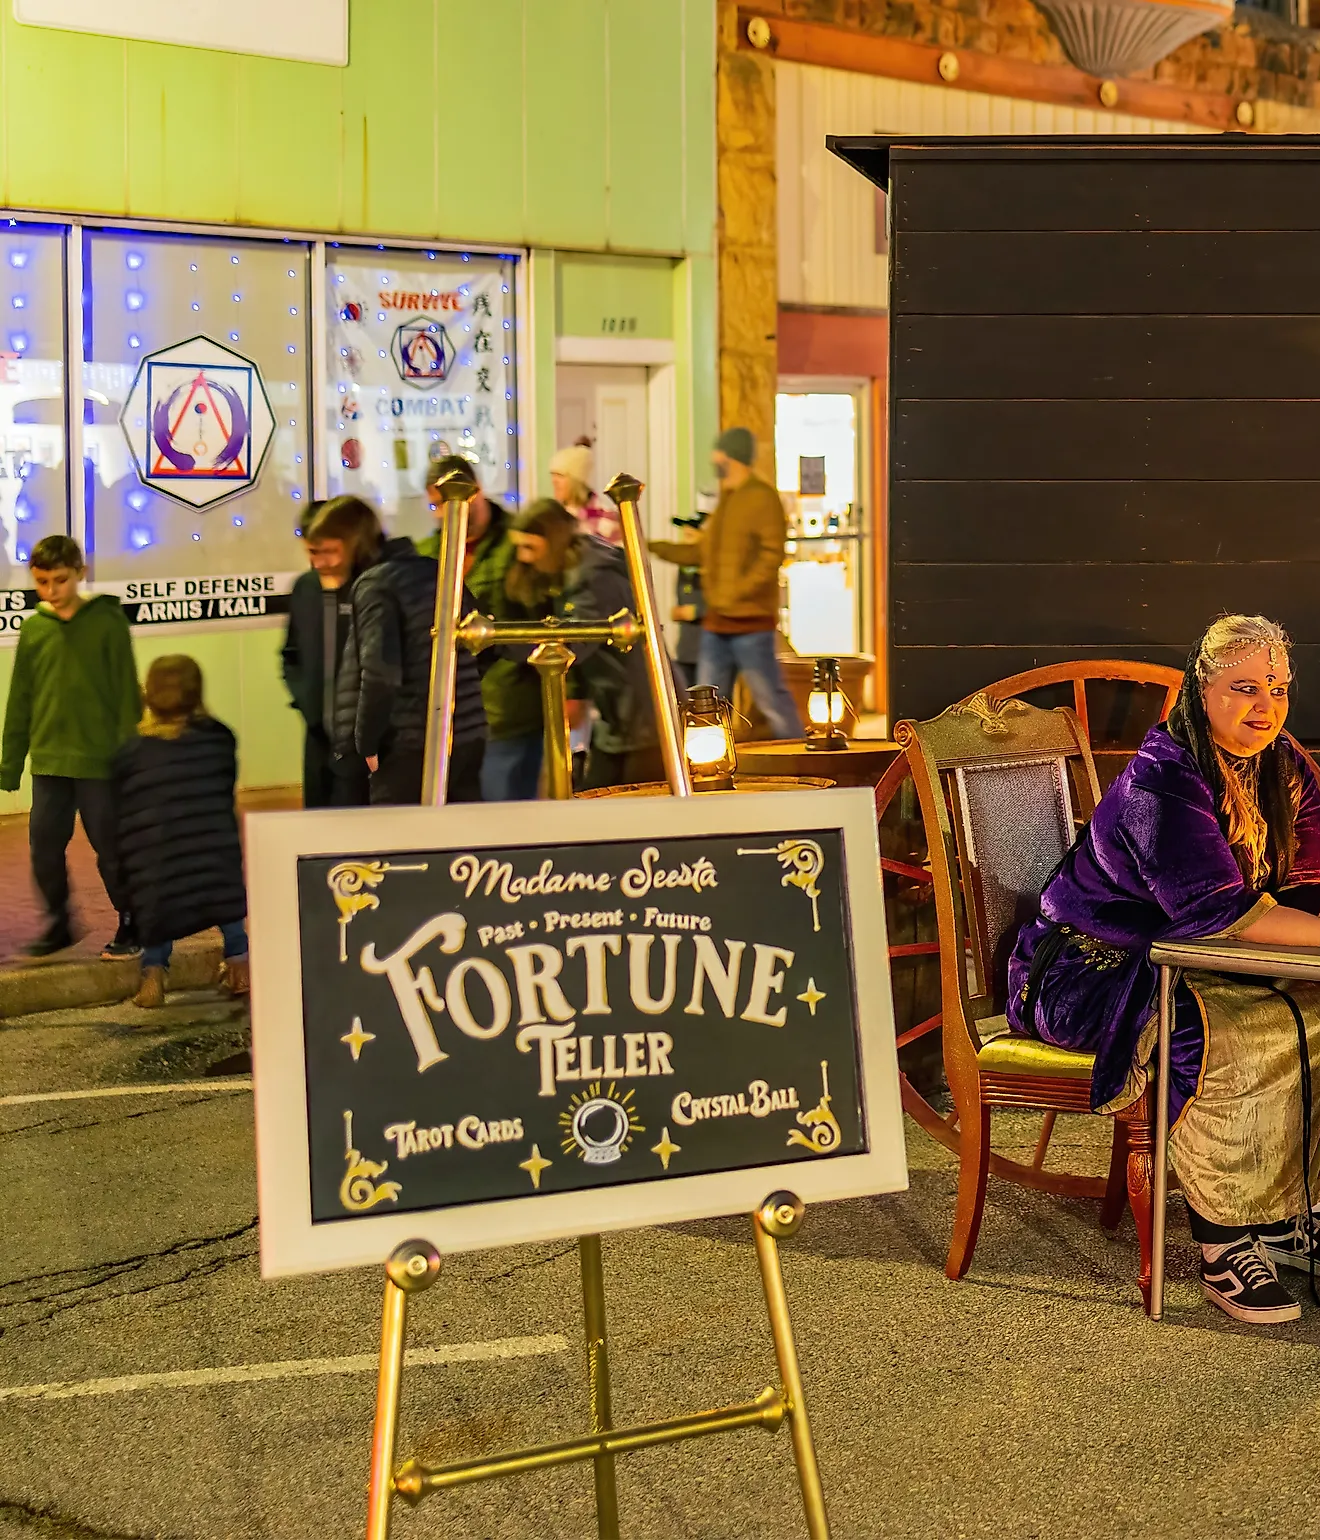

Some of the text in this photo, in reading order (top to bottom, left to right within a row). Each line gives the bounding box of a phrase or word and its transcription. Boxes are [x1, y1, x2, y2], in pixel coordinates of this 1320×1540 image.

[376, 397, 467, 417] COMBAT
[126, 576, 275, 599] SELF DEFENSE
[136, 600, 203, 623] ARNIS
[219, 596, 266, 617] KALI
[450, 846, 719, 903] Madame Seesta
[477, 906, 712, 948] Past Present Future
[359, 911, 796, 1074] FORTUNE
[515, 1021, 675, 1097] TELLER
[671, 1079, 800, 1126] CRYSTAL BALL
[383, 1115, 525, 1160] TAROT CARDS
